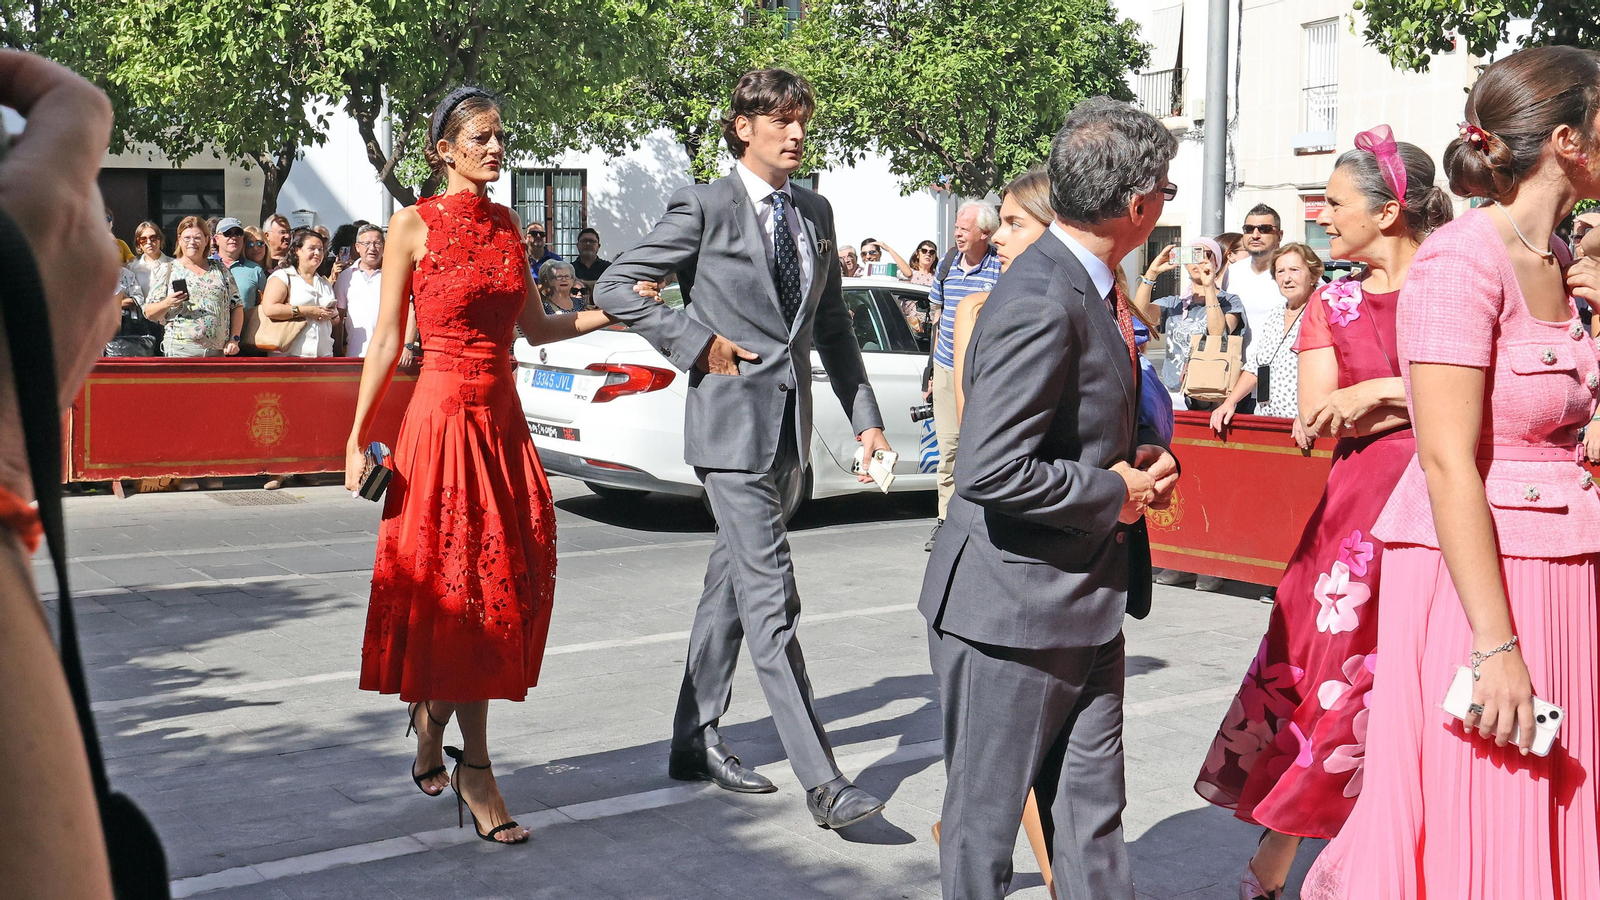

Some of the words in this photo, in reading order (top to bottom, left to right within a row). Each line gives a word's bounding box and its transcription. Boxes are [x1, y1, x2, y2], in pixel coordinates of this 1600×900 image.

[873, 265, 886, 274] TAXI
[535, 372, 555, 388] 3345
[555, 375, 571, 391] JVL
